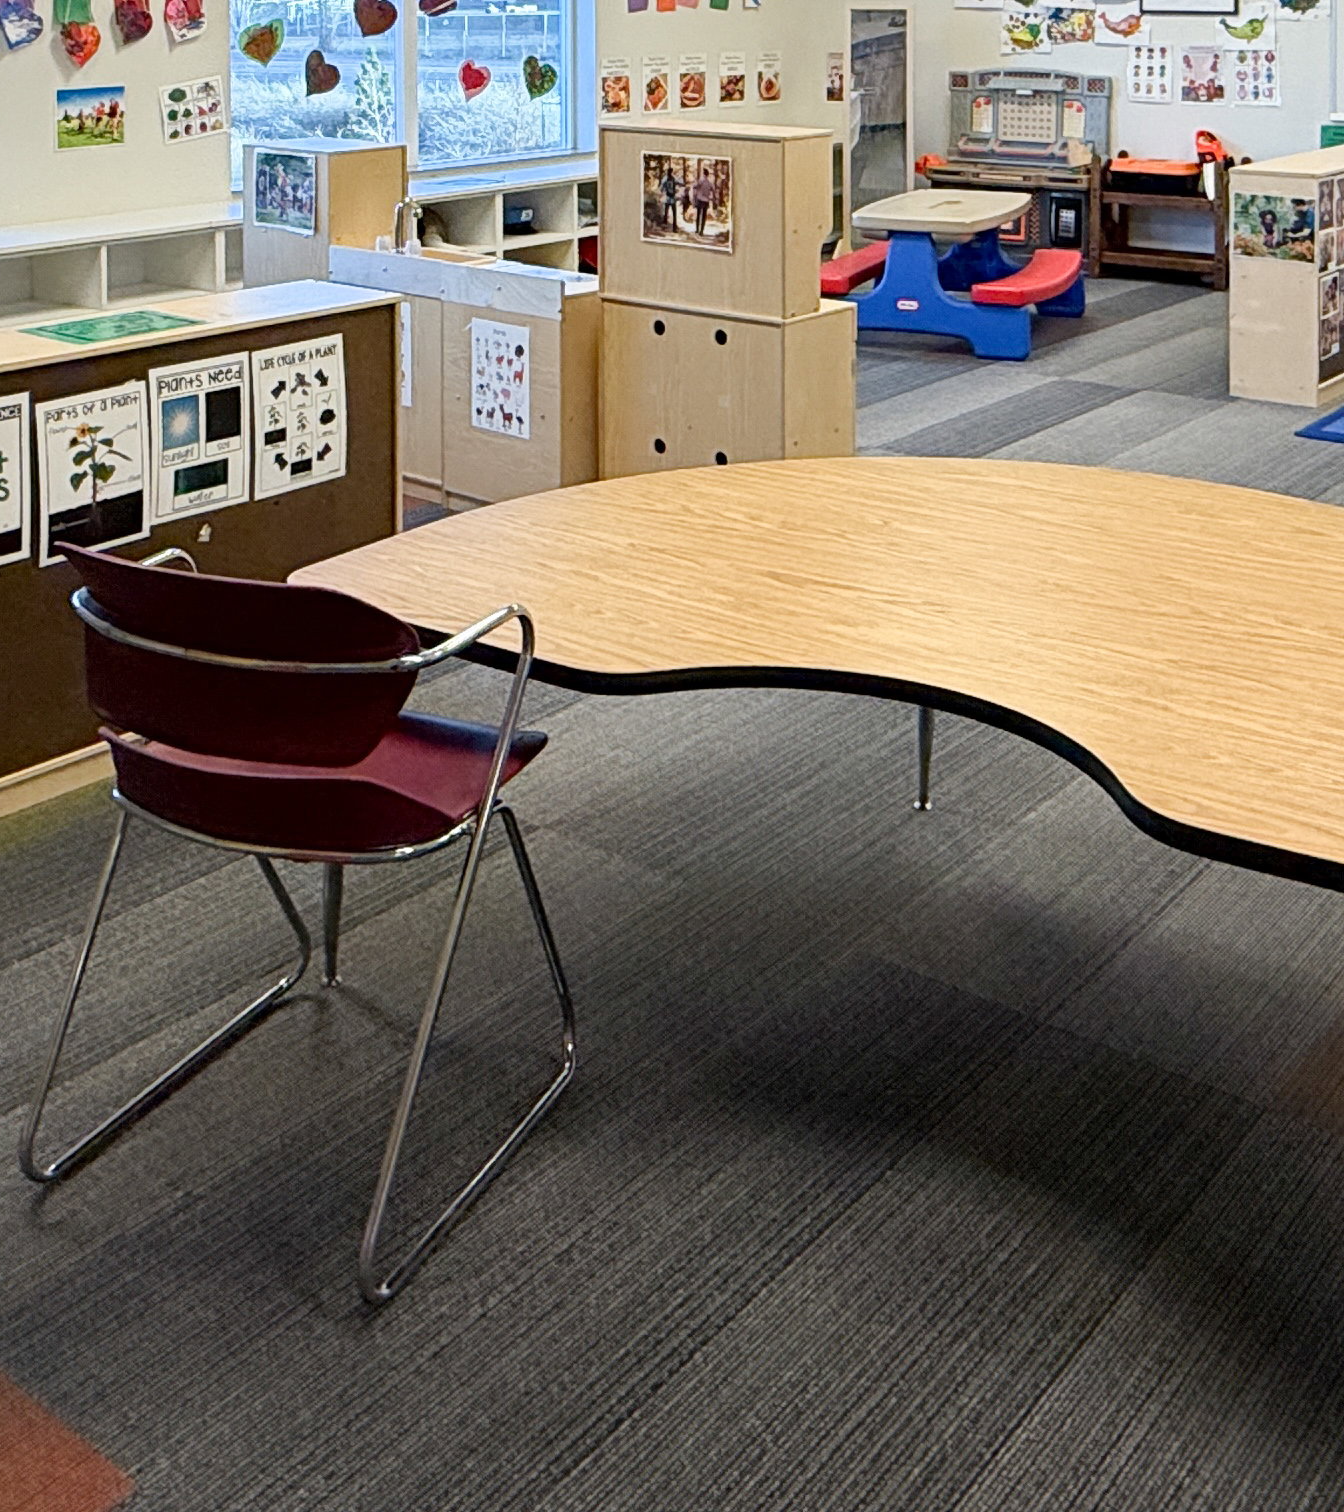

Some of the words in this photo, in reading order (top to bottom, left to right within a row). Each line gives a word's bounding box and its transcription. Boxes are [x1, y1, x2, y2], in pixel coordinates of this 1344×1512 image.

[260, 357, 275, 371] LIFE
[277, 353, 296, 368] CYCLE
[308, 348, 314, 360] A
[315, 344, 337, 359] PLANT
[159, 374, 203, 395] Plants
[208, 365, 243, 386] Need
[46, 407, 78, 423] Parts
[82, 401, 96, 416] of
[100, 399, 108, 412] a
[110, 394, 139, 410] Plant
